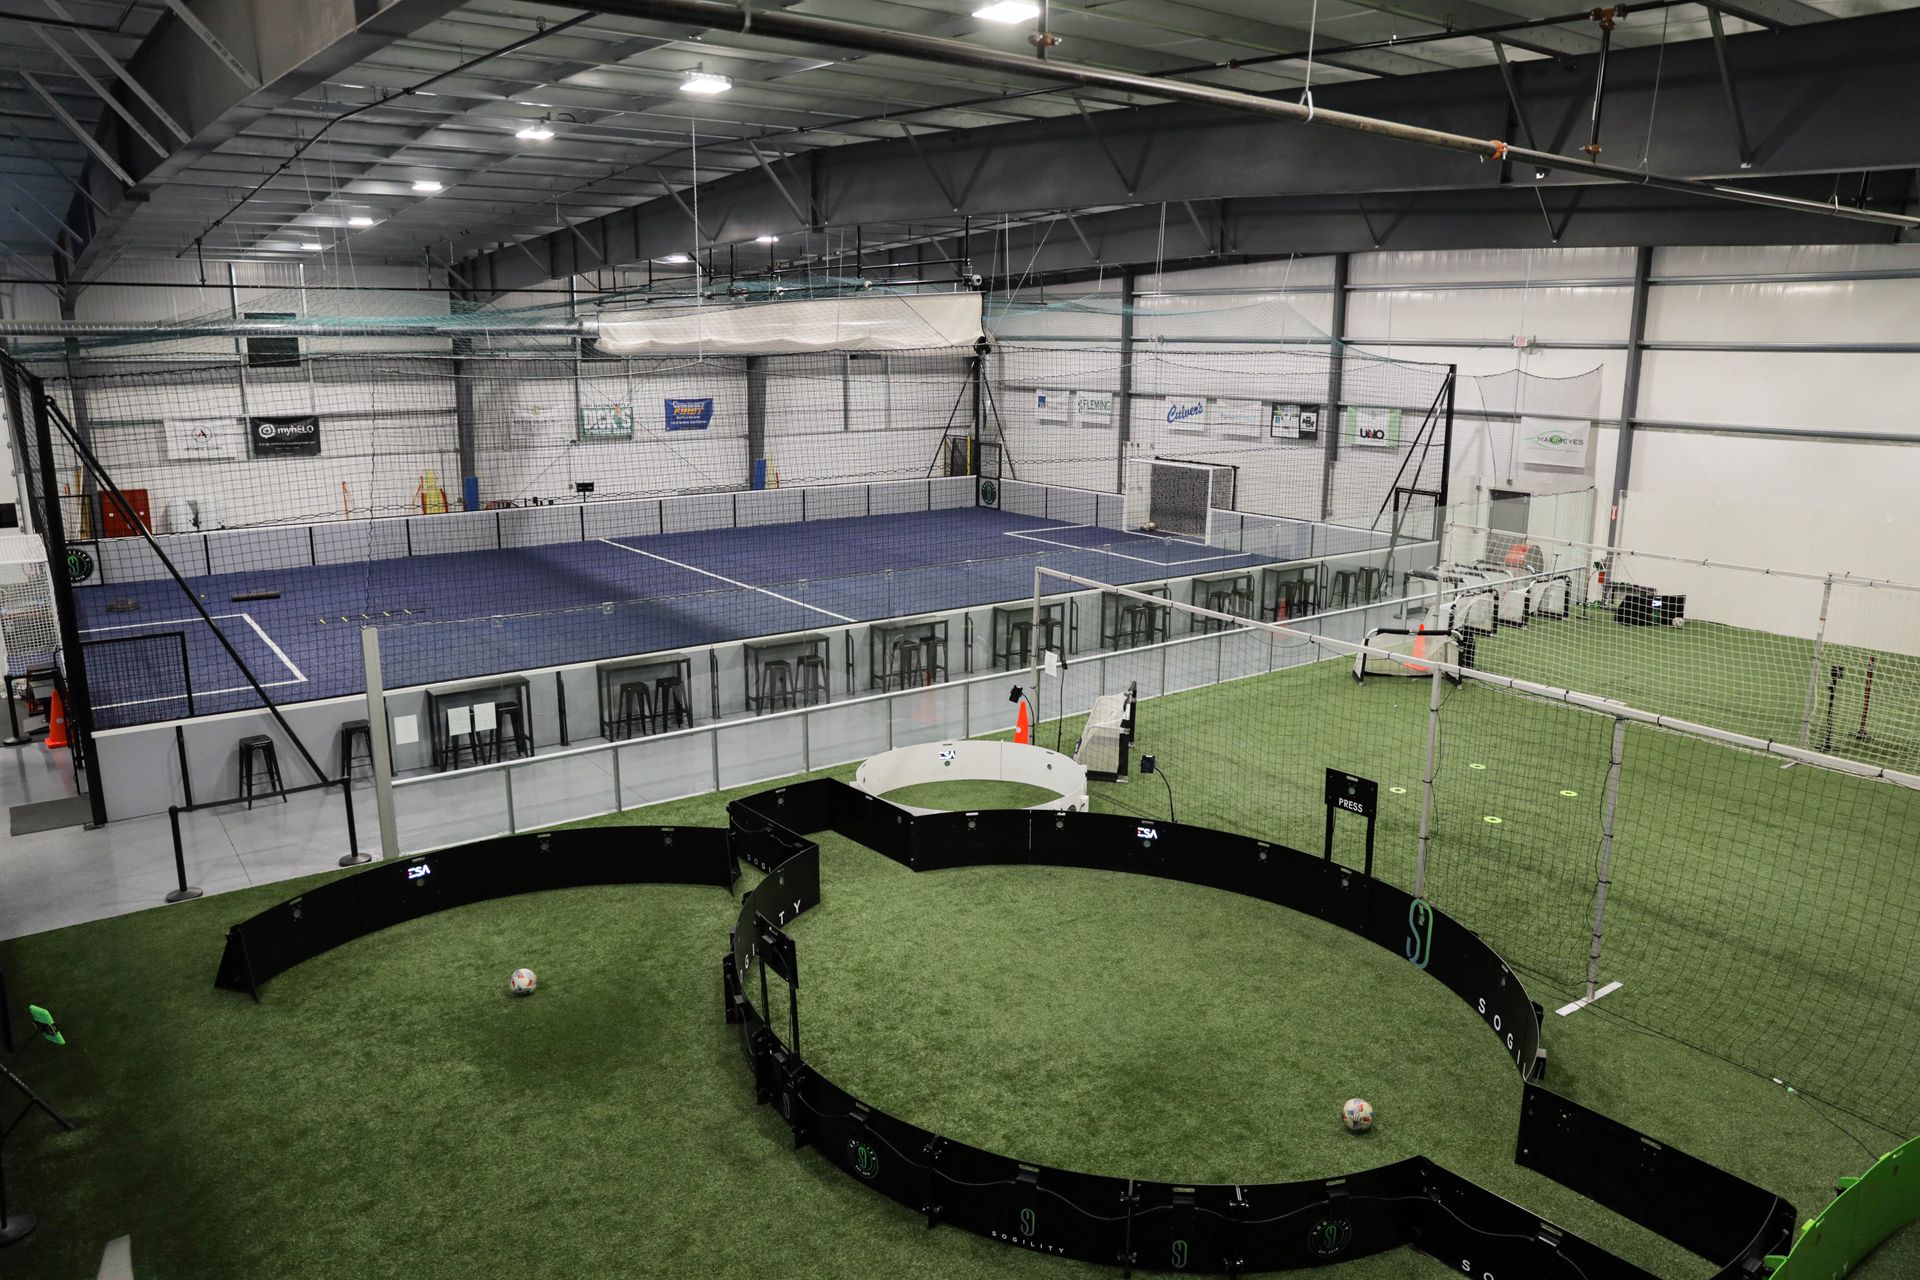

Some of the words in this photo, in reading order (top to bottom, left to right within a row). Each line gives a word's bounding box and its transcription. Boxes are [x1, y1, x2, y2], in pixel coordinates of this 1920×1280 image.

[1167, 402, 1203, 423] Culver's
[278, 425, 314, 436] myhELO
[1338, 798, 1363, 813] PRESS
[992, 1230, 1064, 1253] SOGILITY
